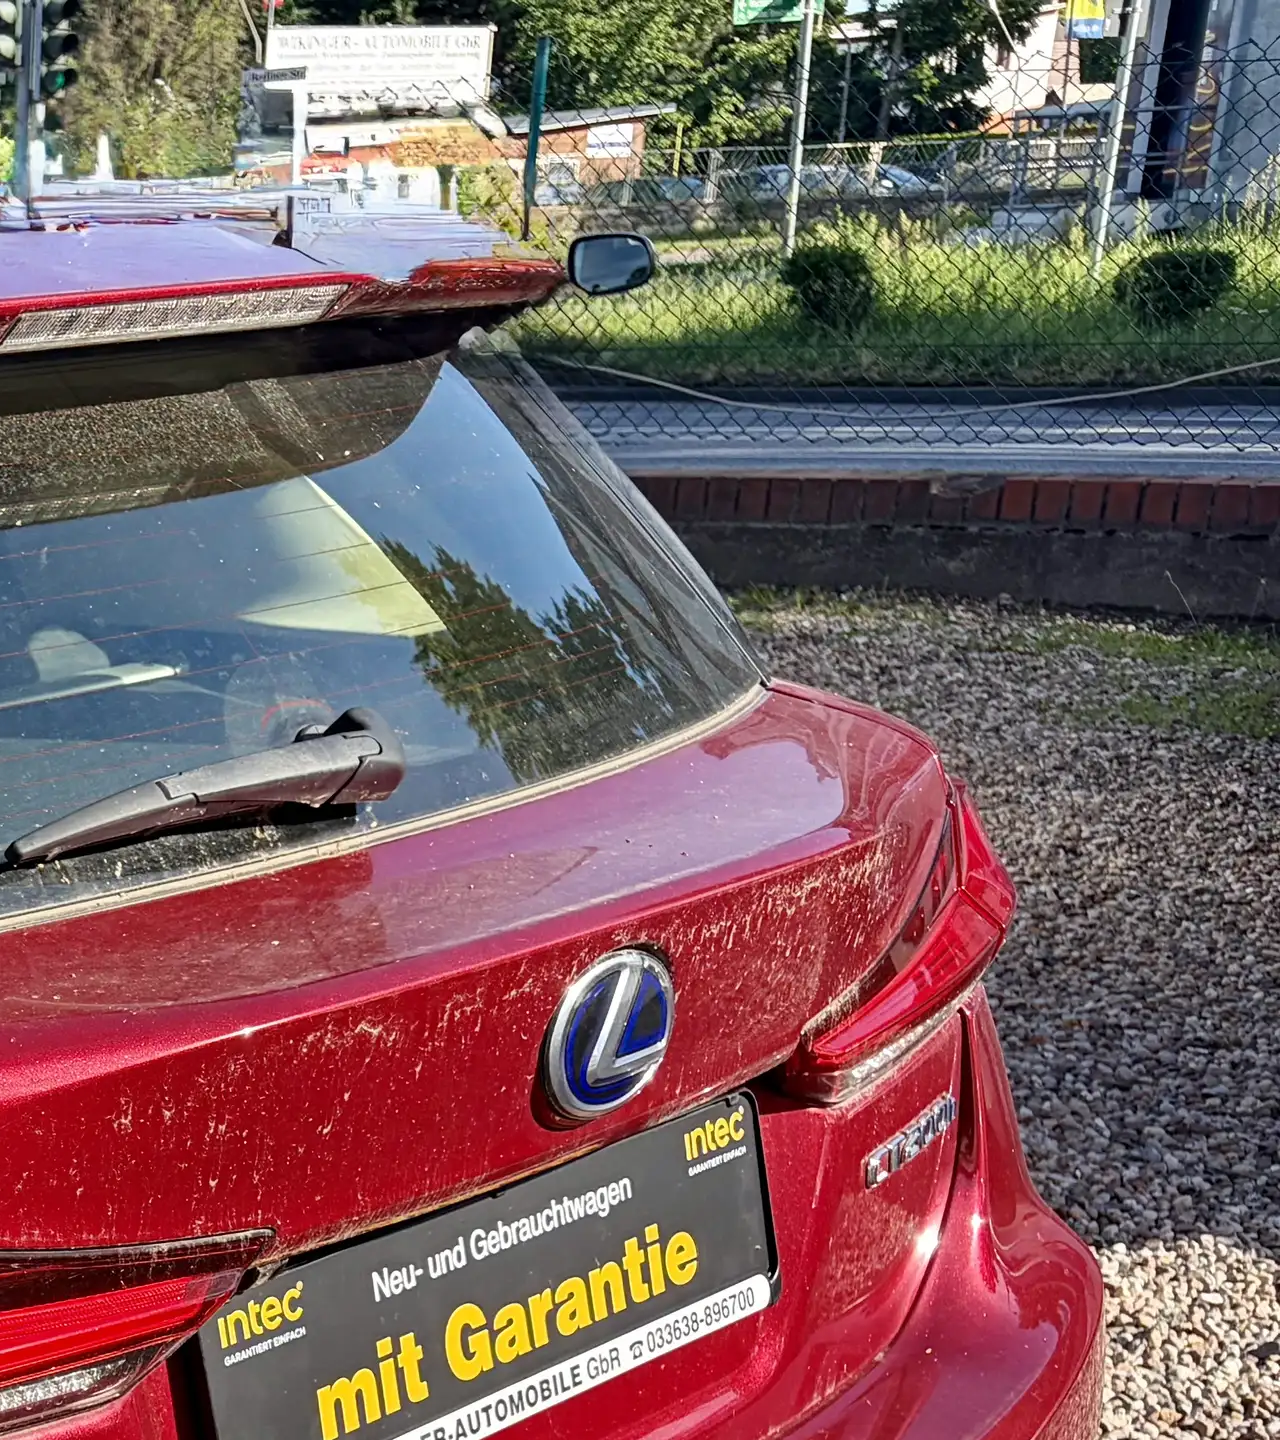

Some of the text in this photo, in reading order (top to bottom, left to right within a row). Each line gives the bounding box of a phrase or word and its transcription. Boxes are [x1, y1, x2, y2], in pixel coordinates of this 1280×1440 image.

[371, 1177, 633, 1303] Neu- und Gebrauchtwagen
[224, 1326, 307, 1367] GARANTIERT EINFACH
[443, 1222, 699, 1382] Garantie
[586, 1347, 622, 1382] GbR
[646, 1286, 756, 1353] 033638-896700
